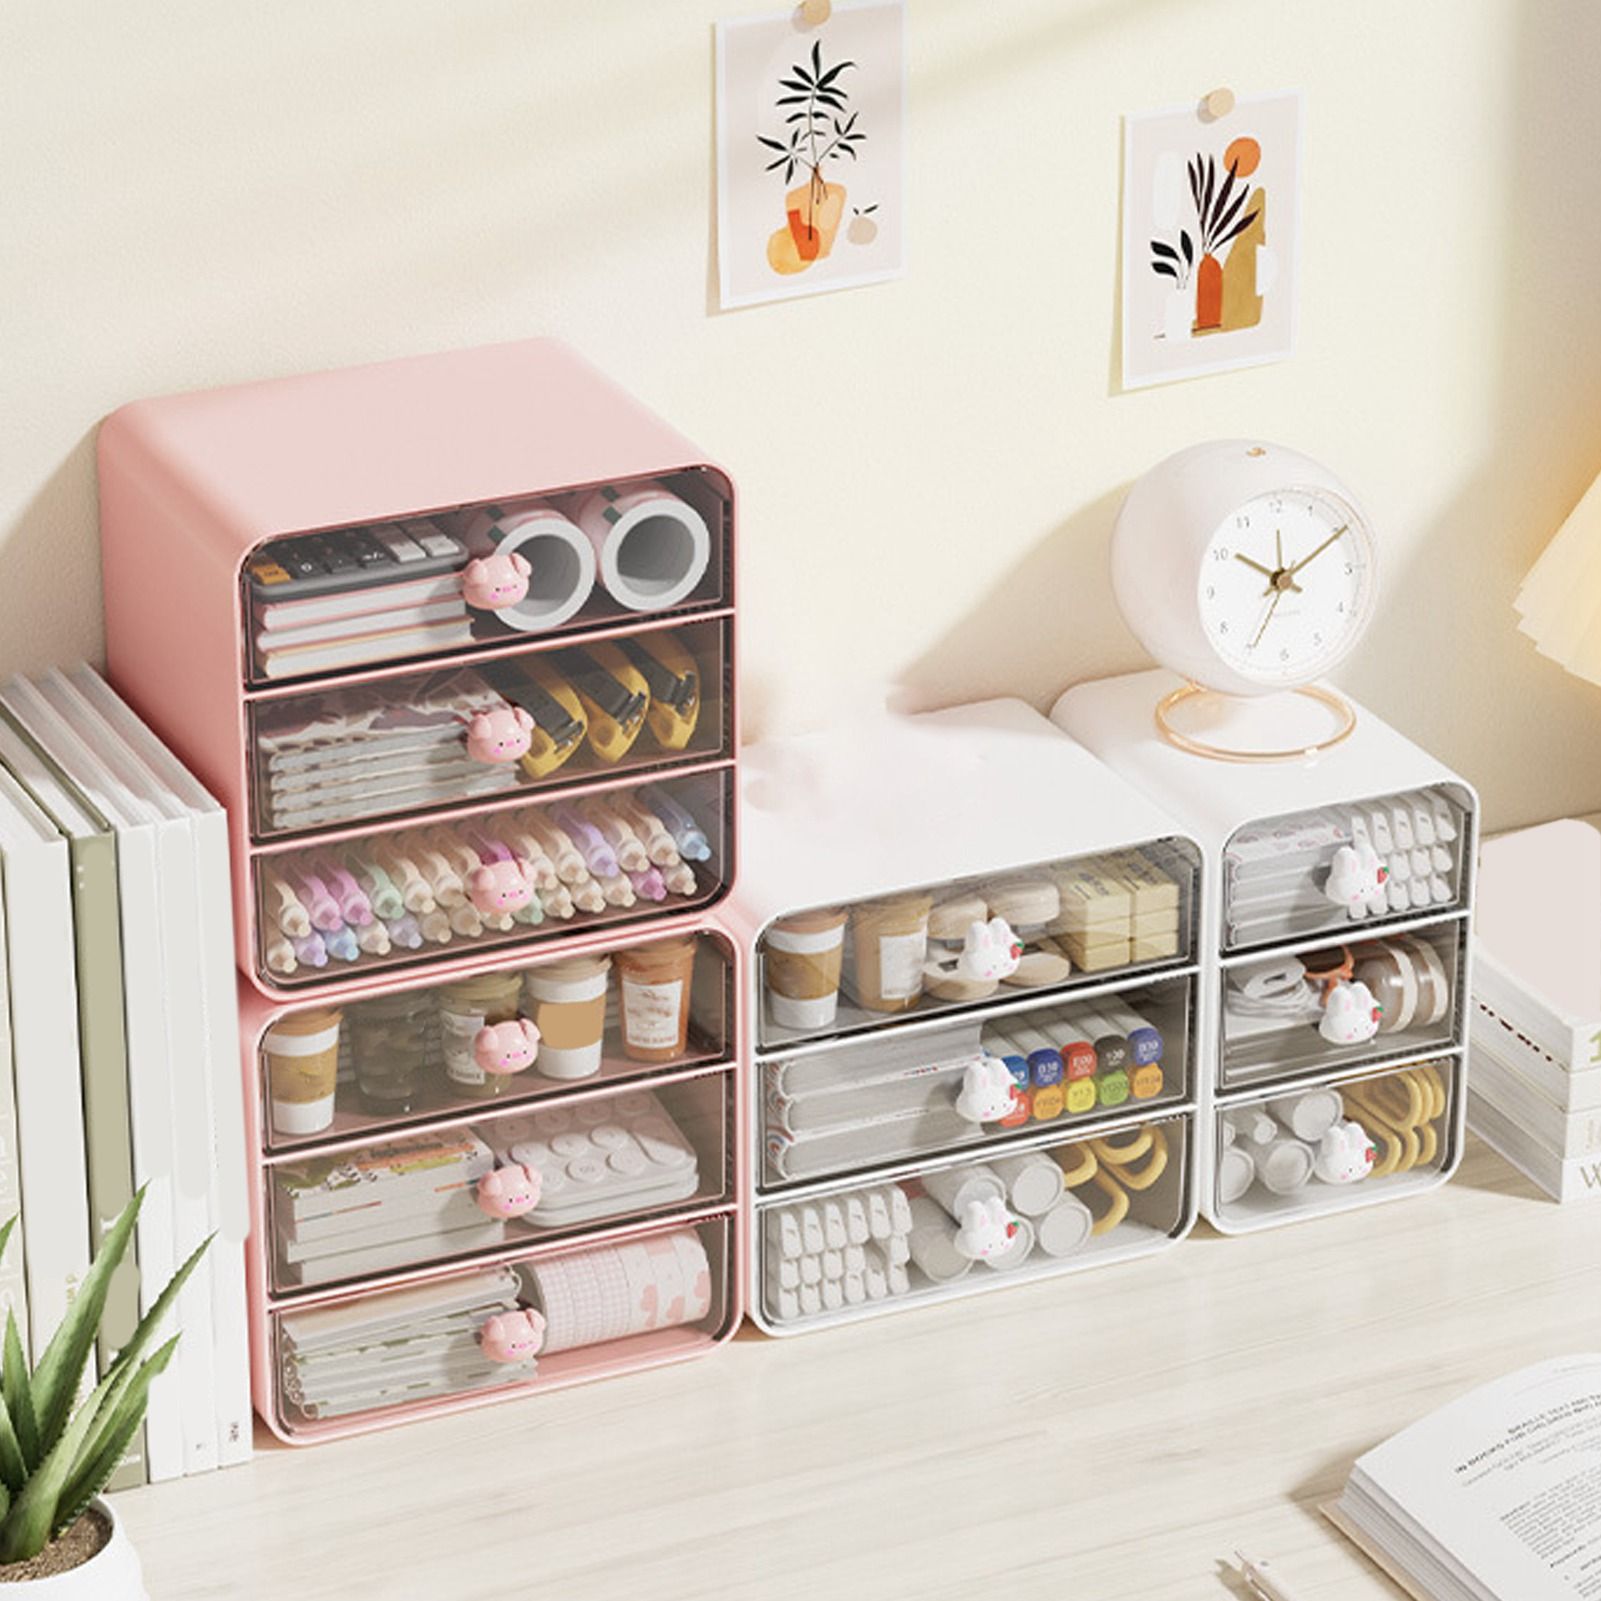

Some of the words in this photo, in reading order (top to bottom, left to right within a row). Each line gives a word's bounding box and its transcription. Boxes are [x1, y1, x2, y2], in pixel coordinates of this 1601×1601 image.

[1269, 500, 1283, 514] 12
[1237, 517, 1250, 528] 11
[1212, 547, 1229, 562] 10
